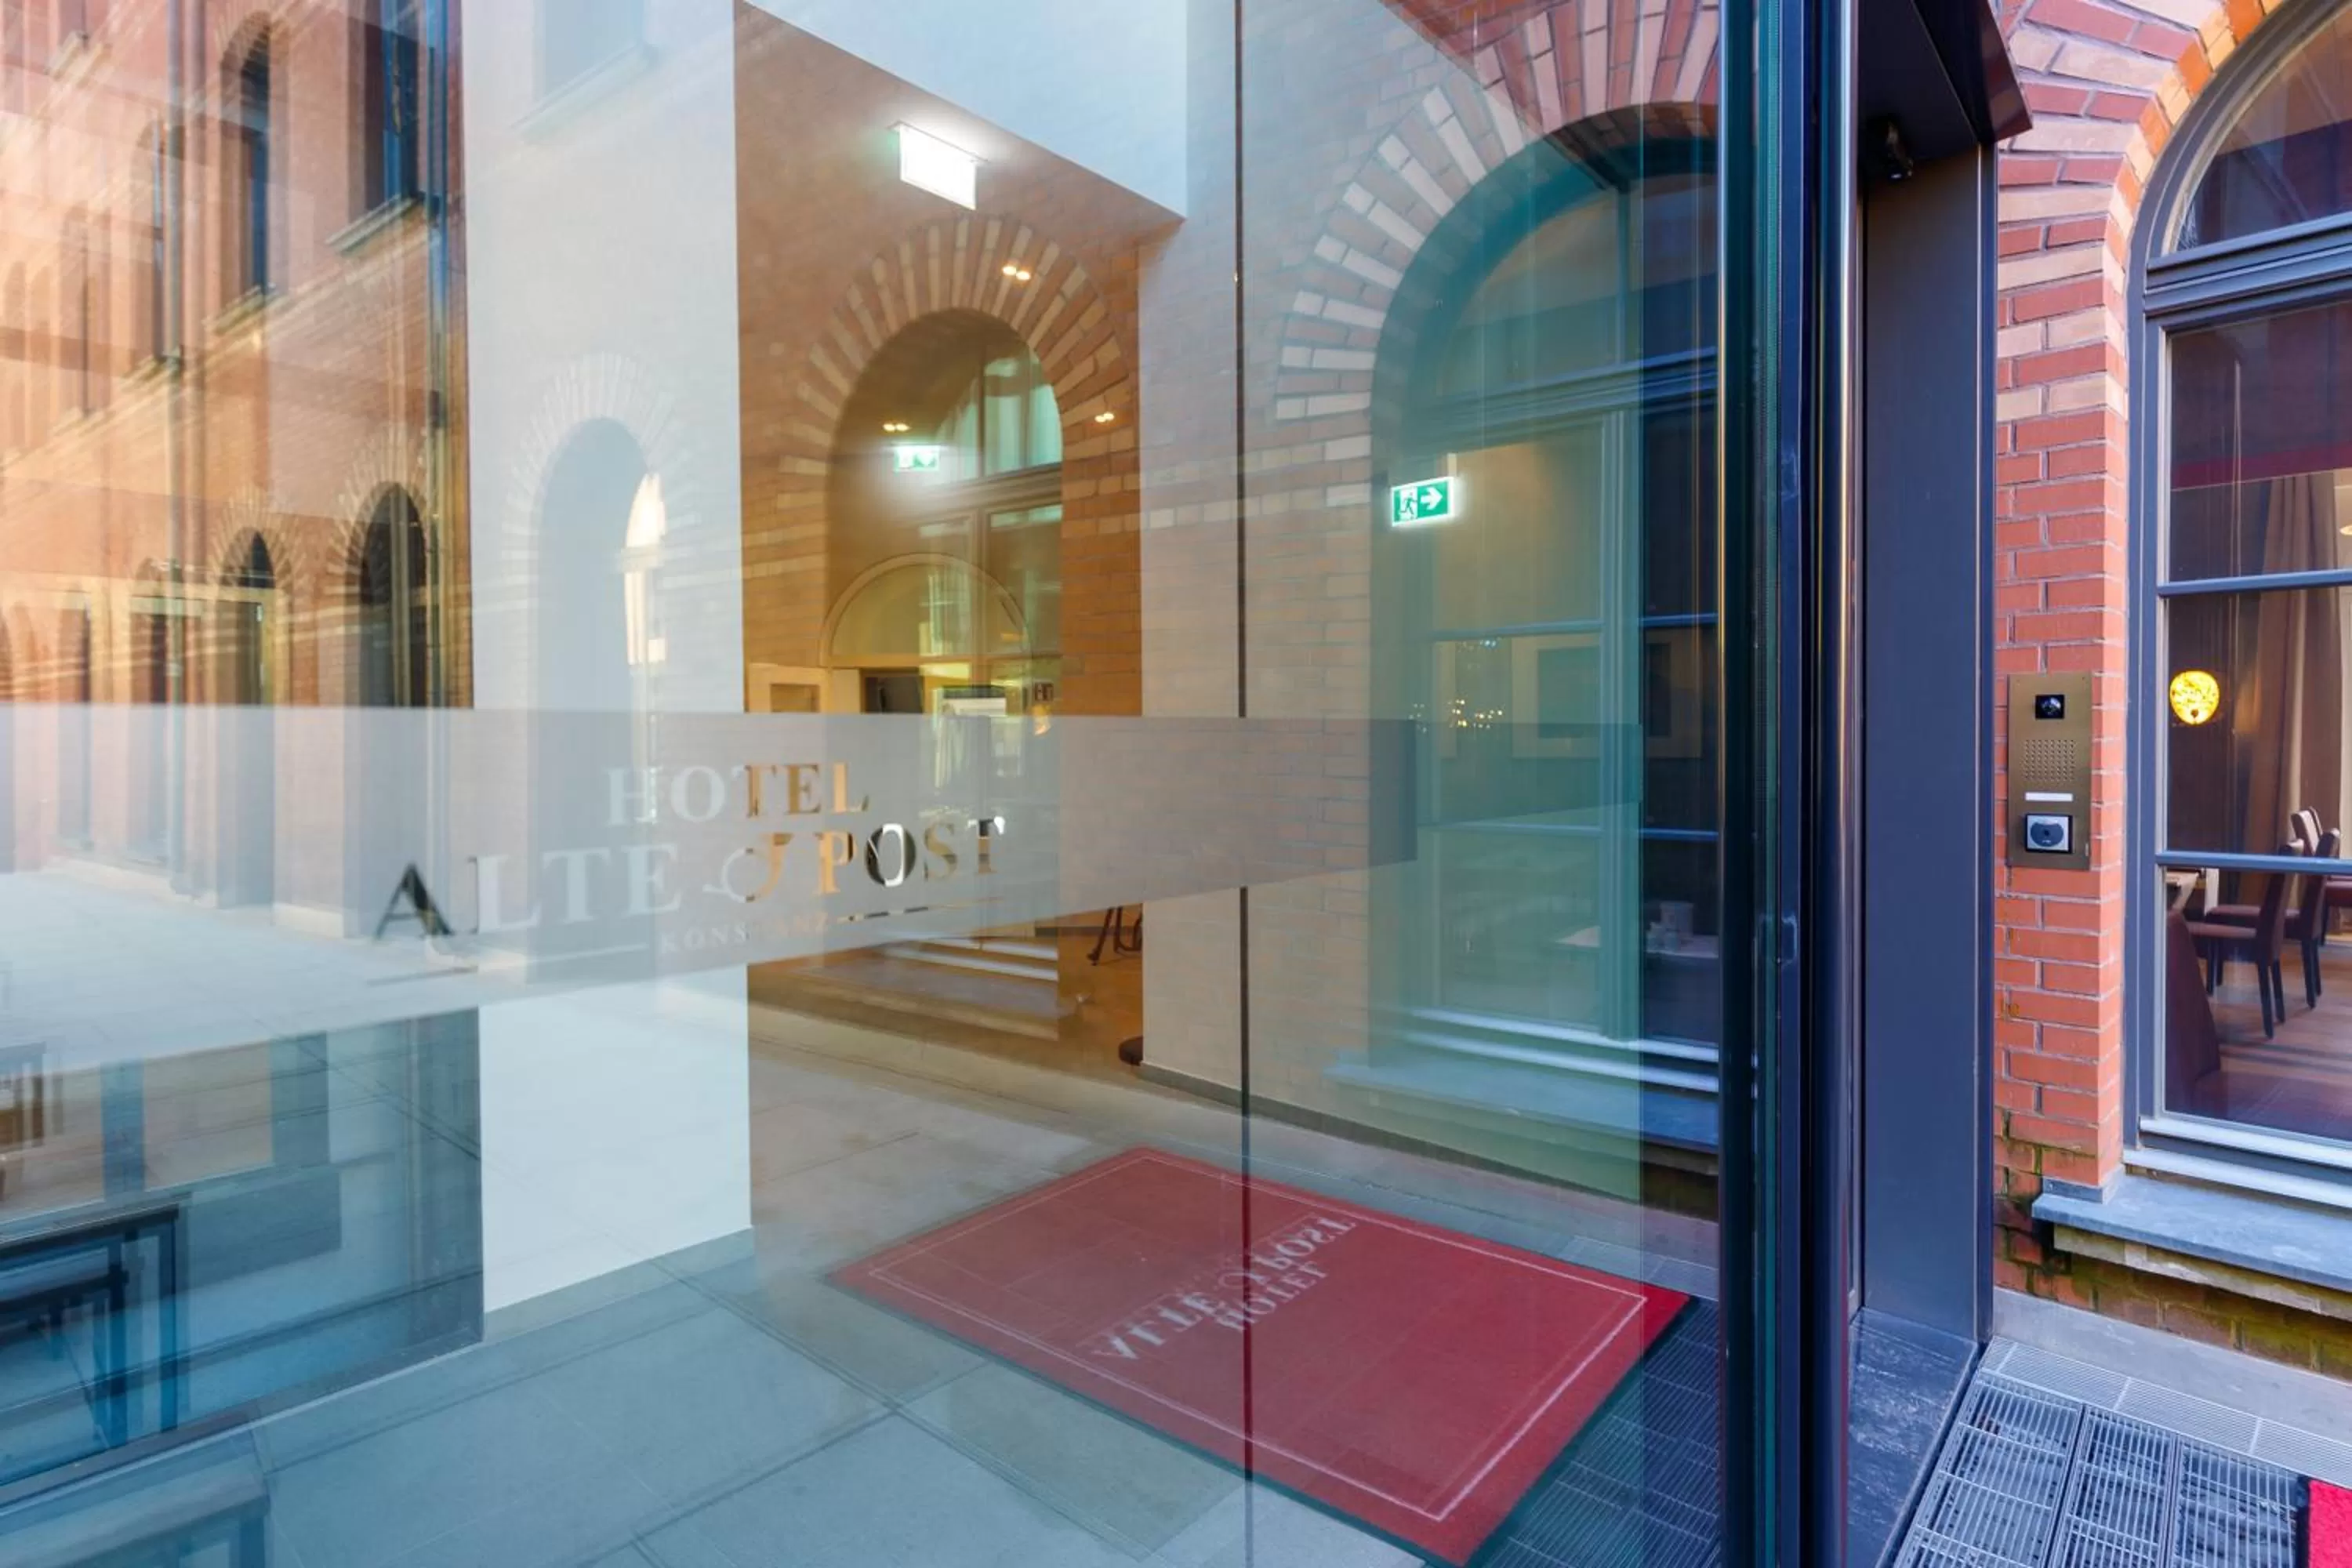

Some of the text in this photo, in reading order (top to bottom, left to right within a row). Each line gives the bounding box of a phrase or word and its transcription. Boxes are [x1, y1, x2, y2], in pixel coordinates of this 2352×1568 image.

[608, 761, 868, 826] HOTEL
[375, 815, 1005, 938] ALTE POST
